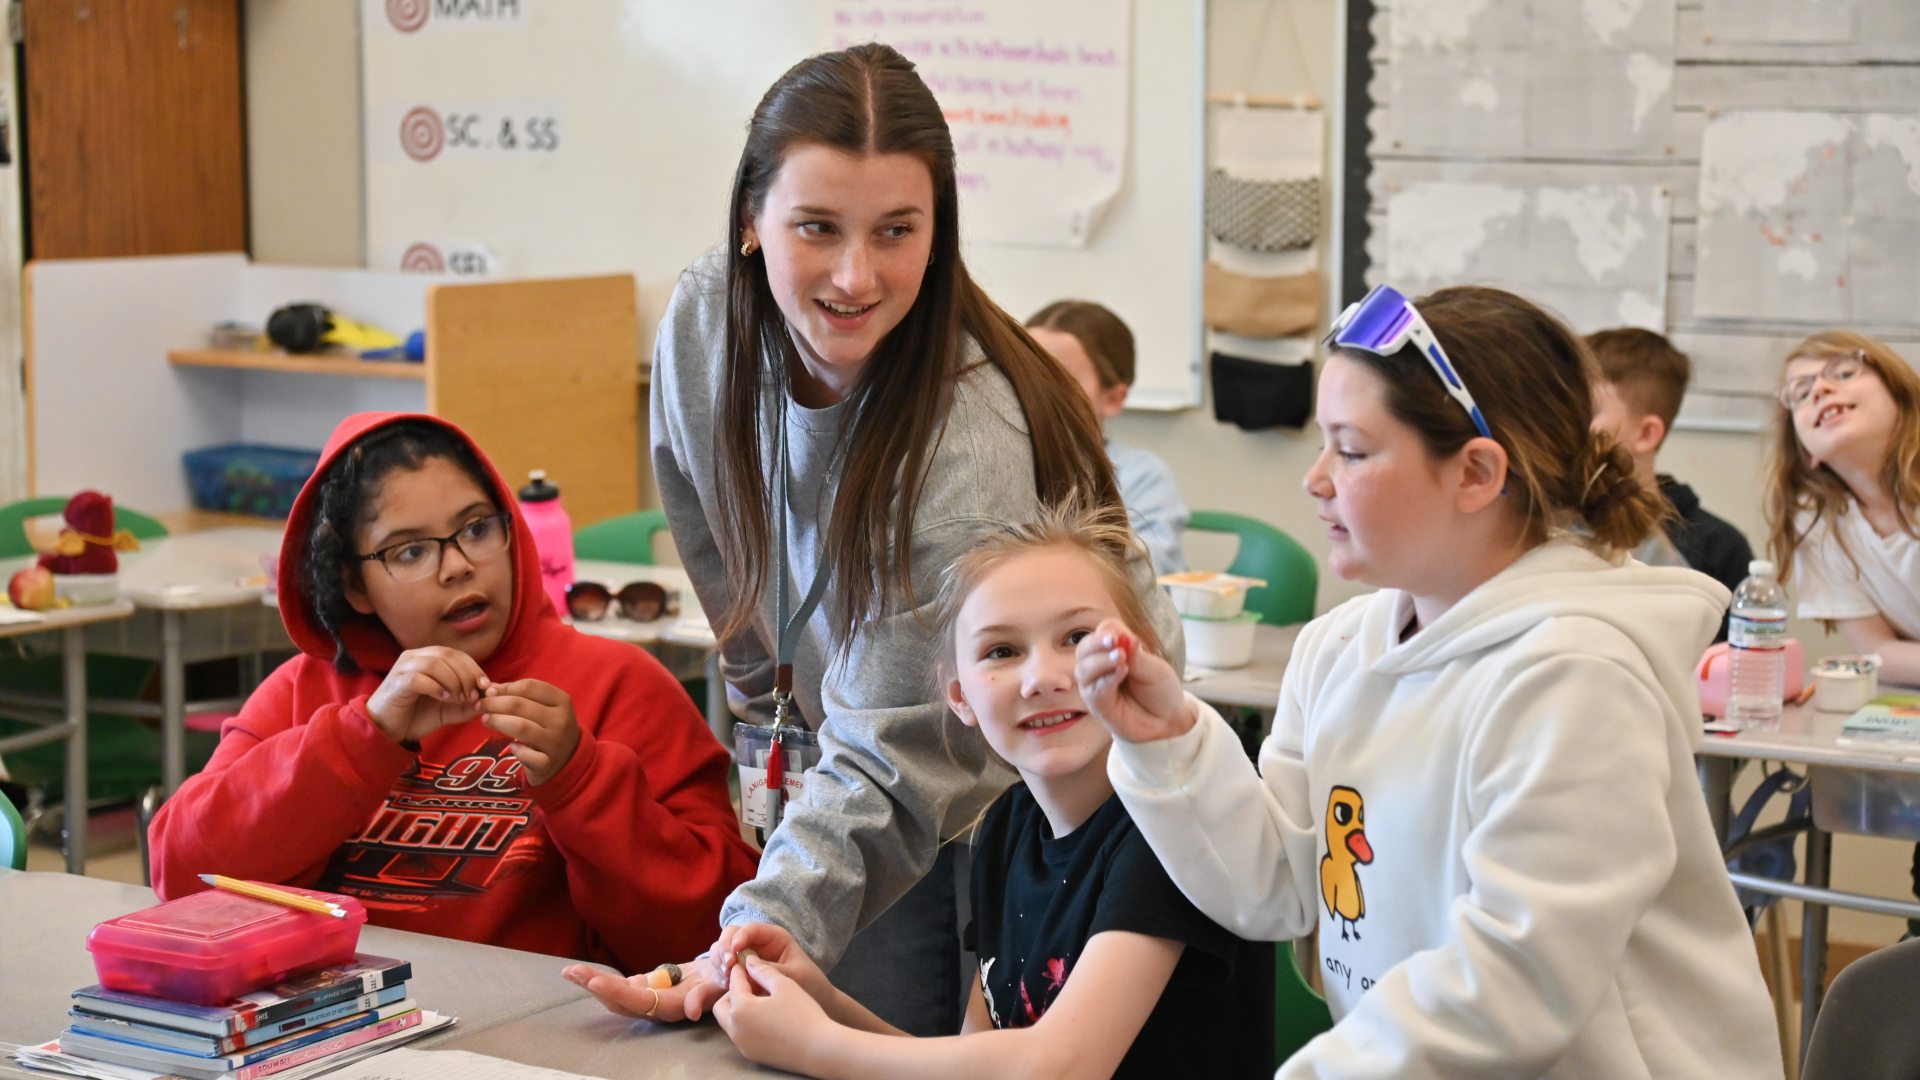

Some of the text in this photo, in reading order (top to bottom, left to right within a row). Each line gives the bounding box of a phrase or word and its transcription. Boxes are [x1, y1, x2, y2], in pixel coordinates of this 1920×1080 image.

[498, 116, 519, 150] &
[525, 116, 560, 152] SS
[434, 755, 525, 793] 99
[398, 797, 521, 810] LARRY
[1325, 957, 1352, 990] any
